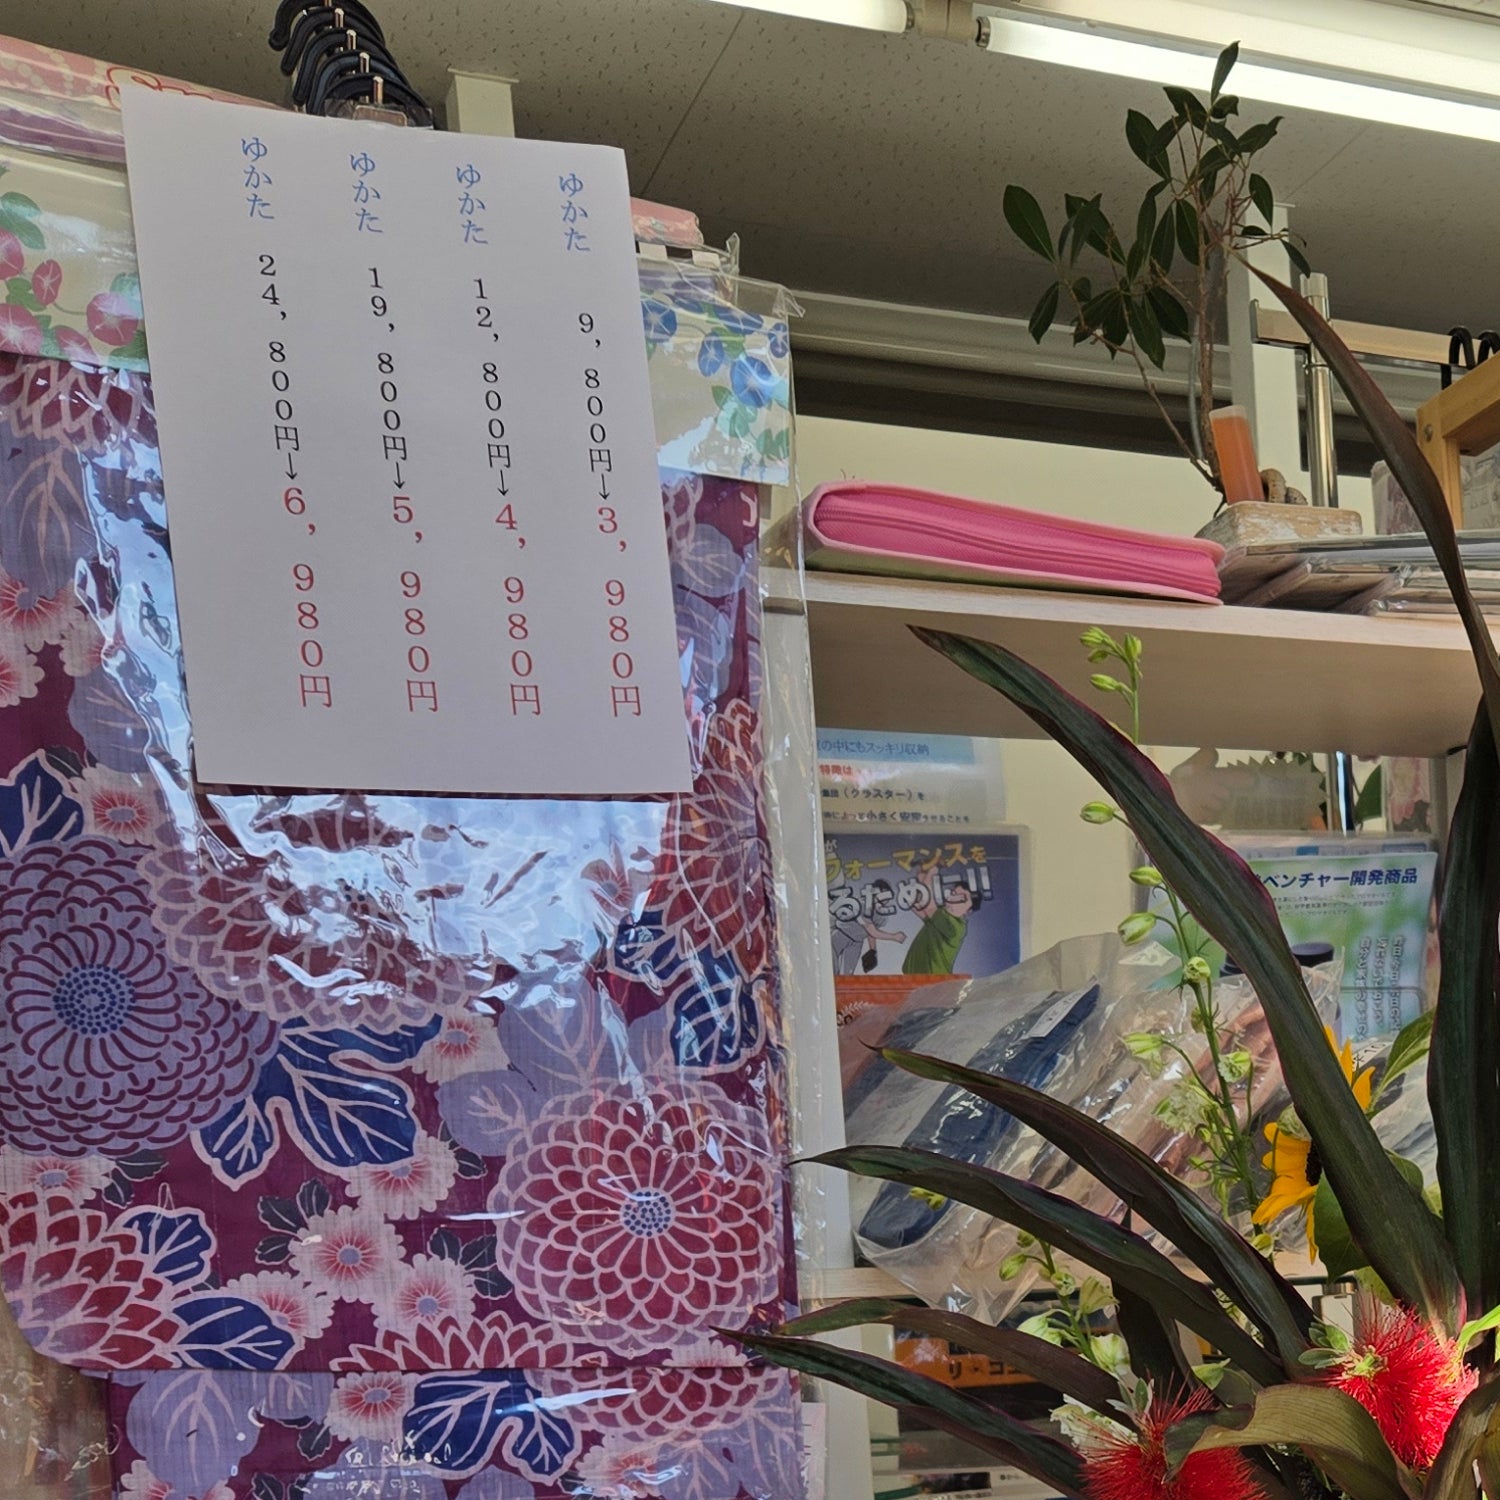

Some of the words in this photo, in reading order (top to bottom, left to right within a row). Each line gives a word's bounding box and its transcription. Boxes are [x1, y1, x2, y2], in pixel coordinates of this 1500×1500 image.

[242, 138, 274, 219] ゆかた
[351, 153, 382, 232] ゆかた
[456, 165, 488, 243] ゆかた
[559, 174, 589, 250] ゆかた
[1256, 867, 1419, 888] ベンチャー開発商品
